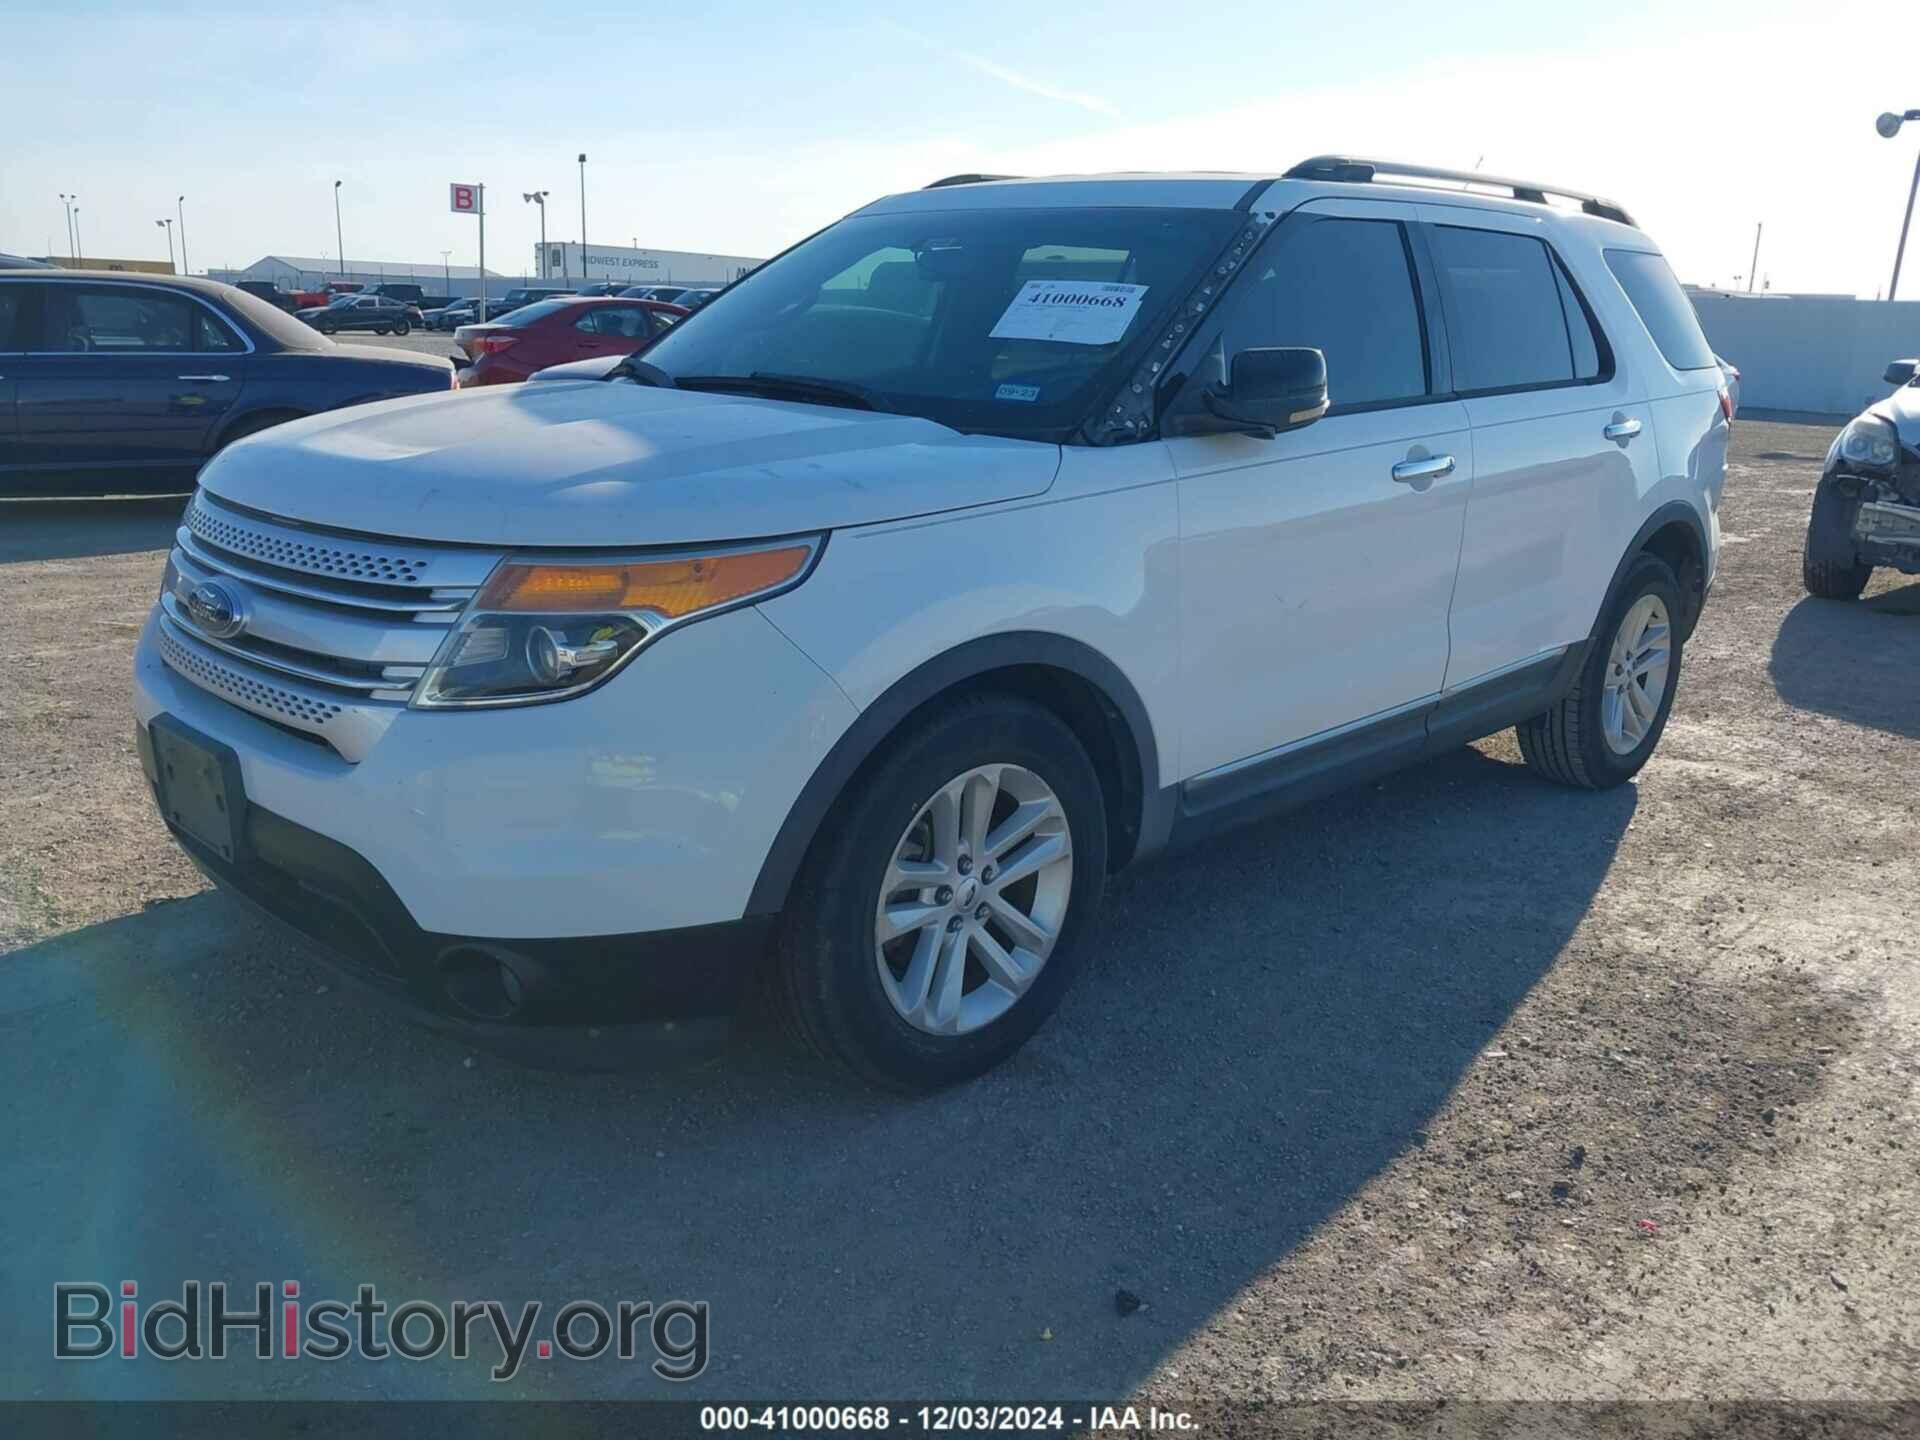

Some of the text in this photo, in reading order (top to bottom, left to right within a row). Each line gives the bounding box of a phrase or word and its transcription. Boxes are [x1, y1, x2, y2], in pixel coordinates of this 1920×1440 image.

[455, 187, 473, 210] B
[622, 257, 659, 269] EXPRESS
[1027, 292, 1127, 308] 41000668
